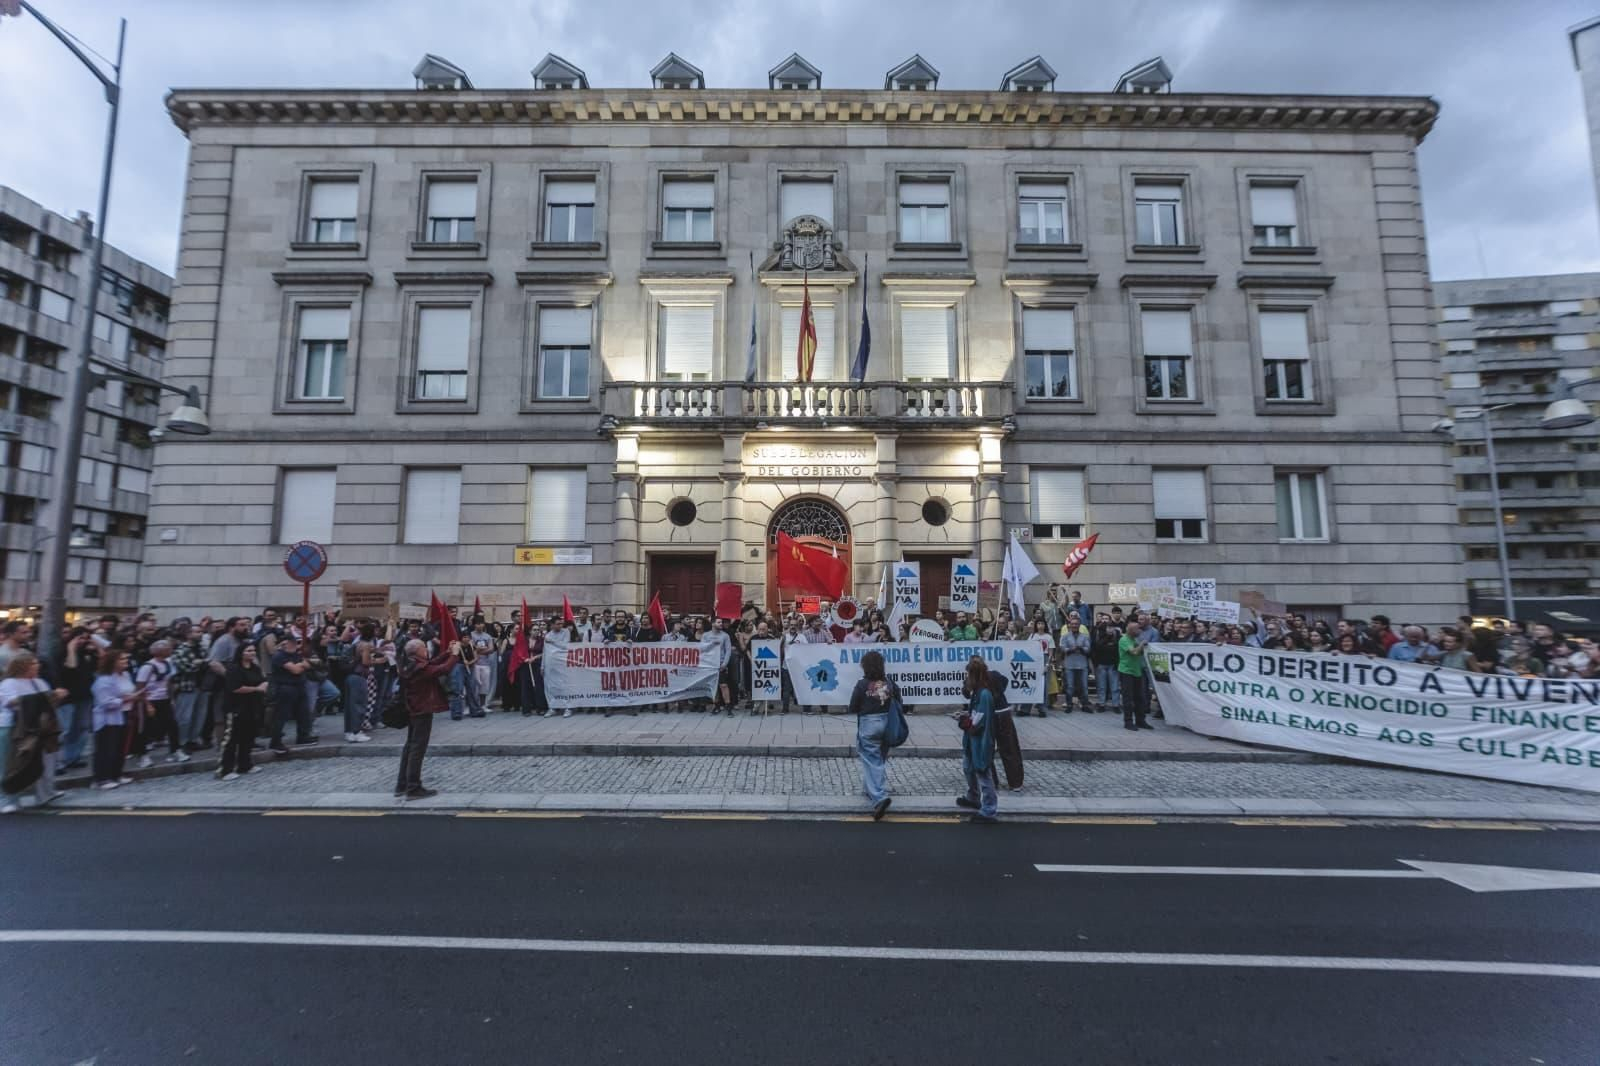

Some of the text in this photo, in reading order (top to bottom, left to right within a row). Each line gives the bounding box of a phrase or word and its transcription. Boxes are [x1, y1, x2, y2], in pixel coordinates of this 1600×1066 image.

[759, 466, 862, 476] DEL GOBIERNO
[954, 585, 976, 594] VEN
[952, 594, 970, 602] DA
[567, 647, 700, 668] ACABEMOS CO NEGOCIO
[840, 648, 849, 664] A
[914, 644, 921, 662] É
[924, 647, 944, 662] UN
[1011, 663, 1023, 671] VI
[1170, 652, 1245, 673] POLO
[1258, 655, 1398, 687] DEREITO
[754, 670, 779, 678] VEN
[1011, 672, 1036, 680] VEN
[601, 672, 617, 691] DA
[620, 669, 669, 691] VIVENDA
[754, 680, 772, 688] DA
[1011, 680, 1030, 689] DA
[902, 686, 932, 696] ública
[935, 688, 941, 696] e
[1197, 679, 1600, 733] CONTRA O XENOCIDIO FINANCE
[1221, 706, 1359, 736] SINALEMOS
[1377, 727, 1434, 747] AOS
